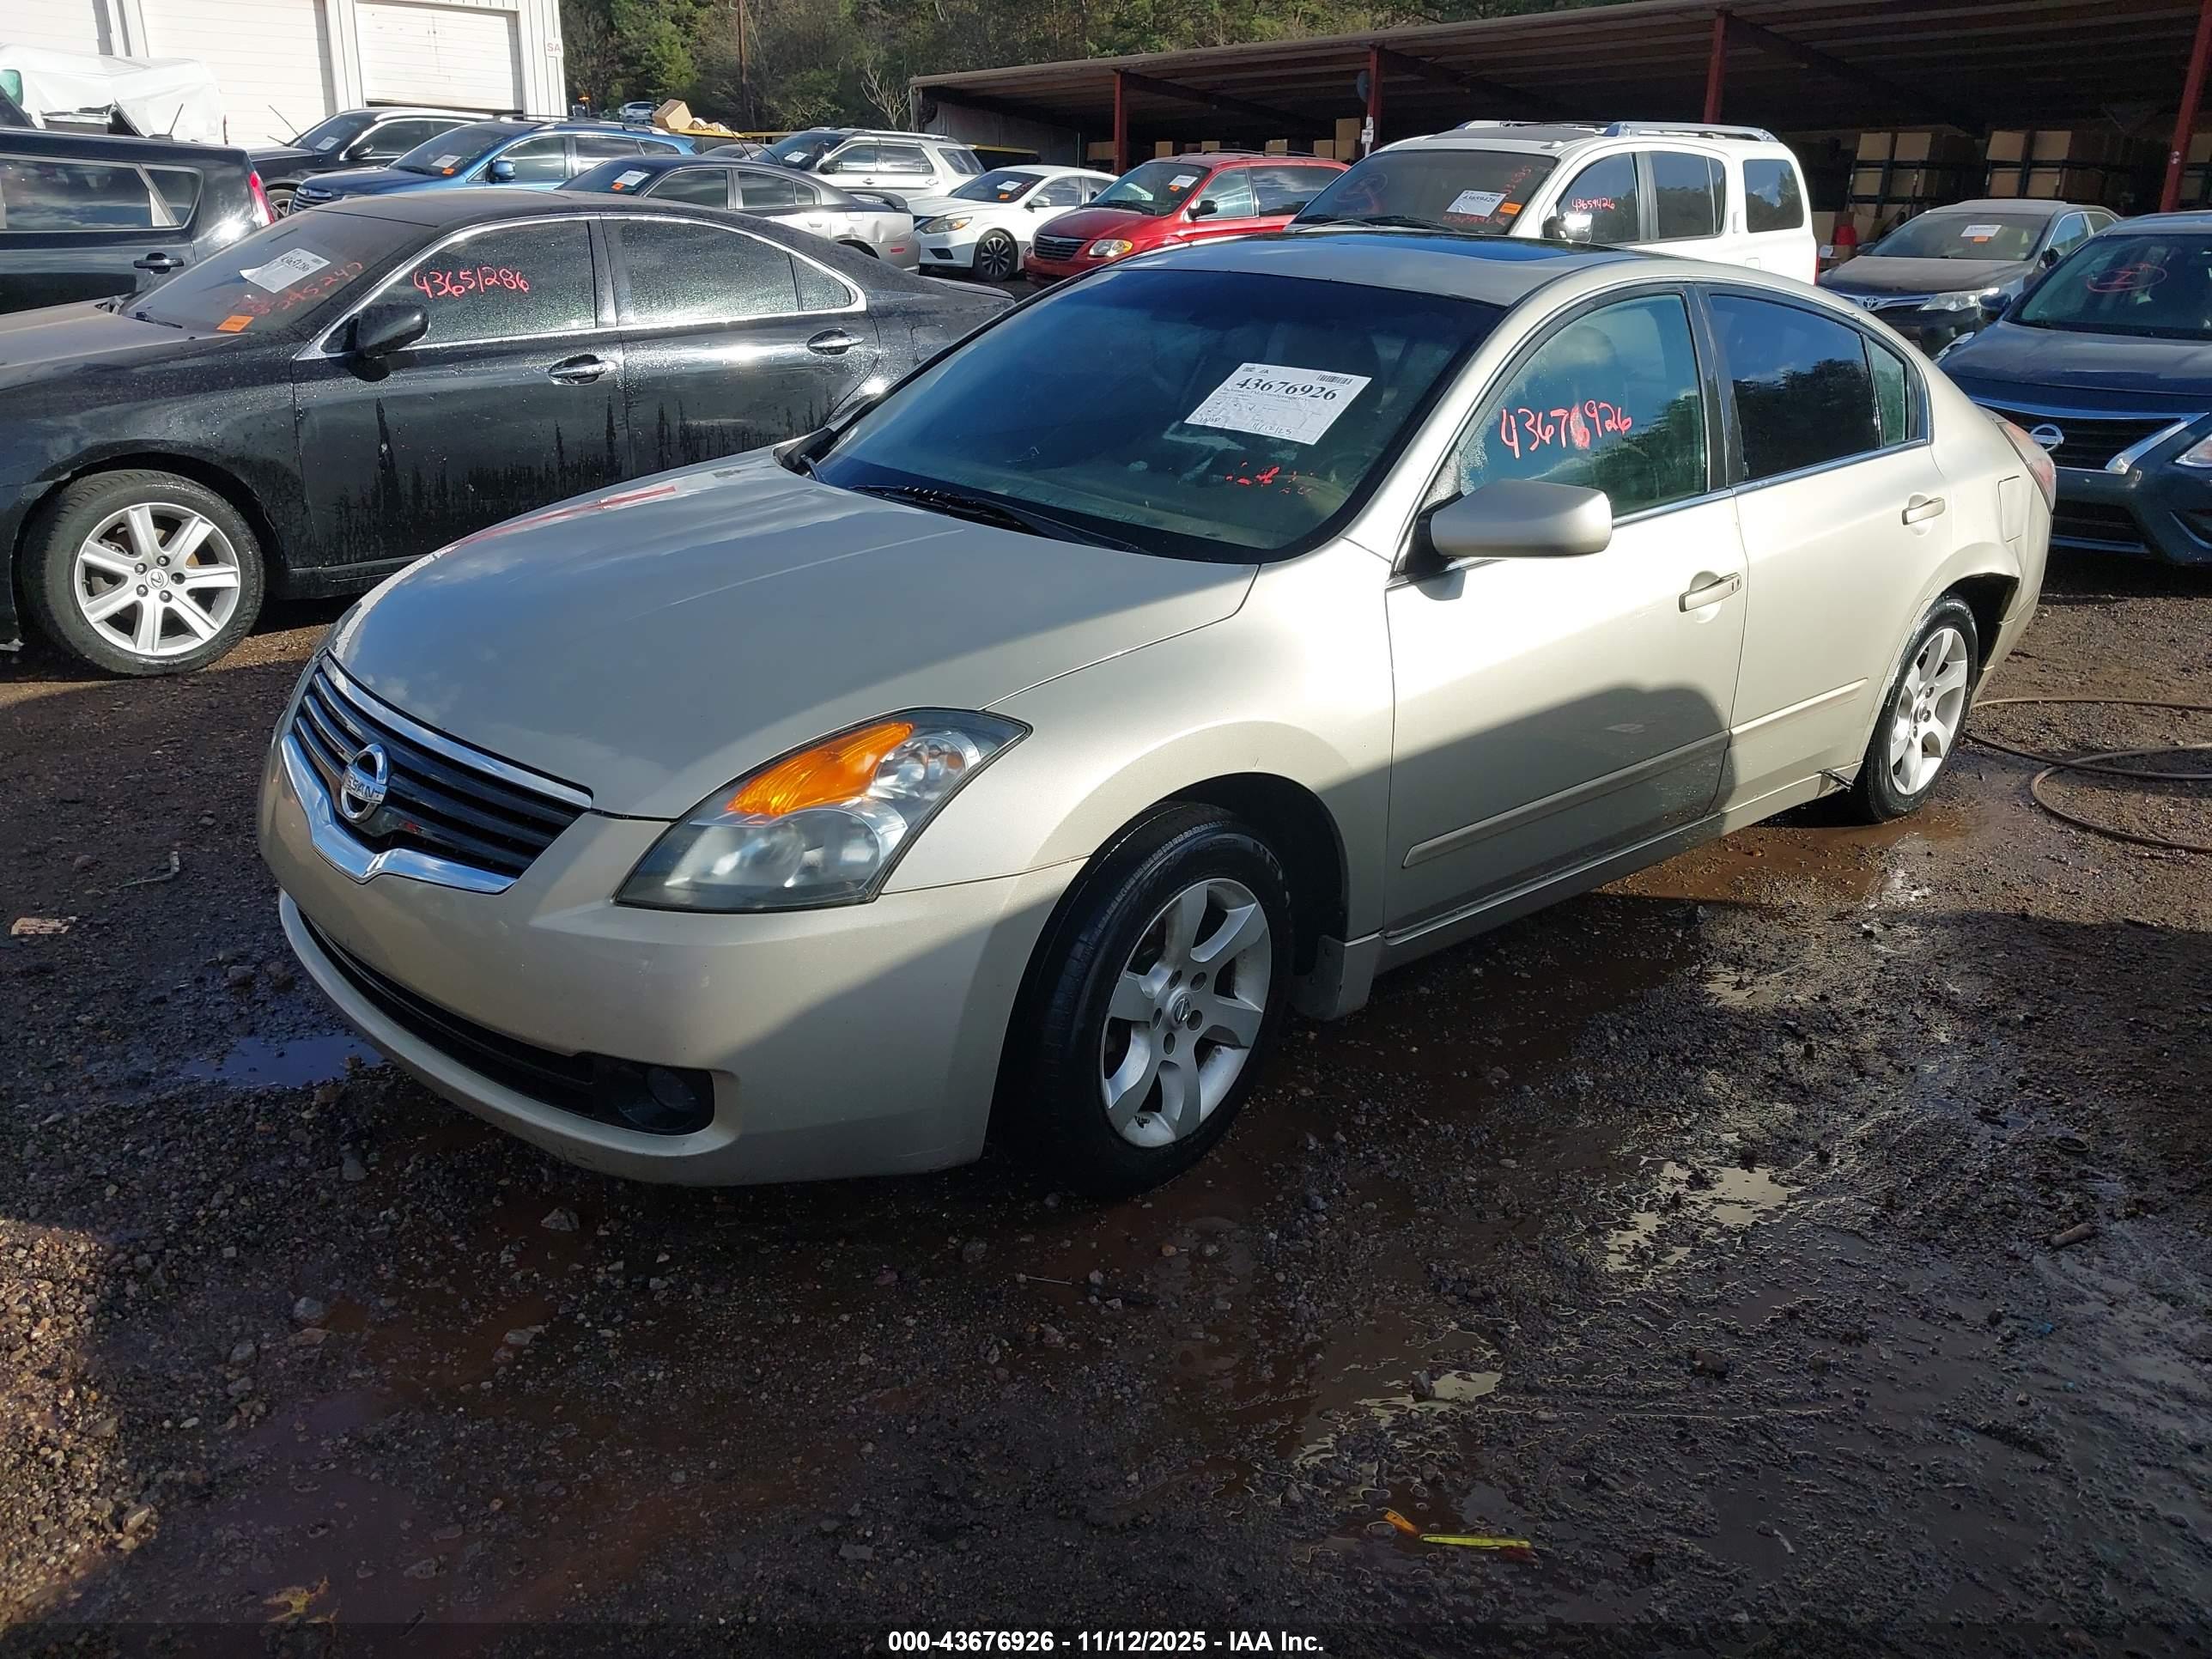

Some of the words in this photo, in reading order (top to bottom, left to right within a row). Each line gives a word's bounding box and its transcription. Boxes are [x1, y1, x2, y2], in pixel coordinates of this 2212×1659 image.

[1571, 197, 1615, 212] 43659426
[413, 266, 530, 299] 43651286
[1236, 376, 1342, 401] 43676926
[1500, 399, 1632, 459] 43676926
